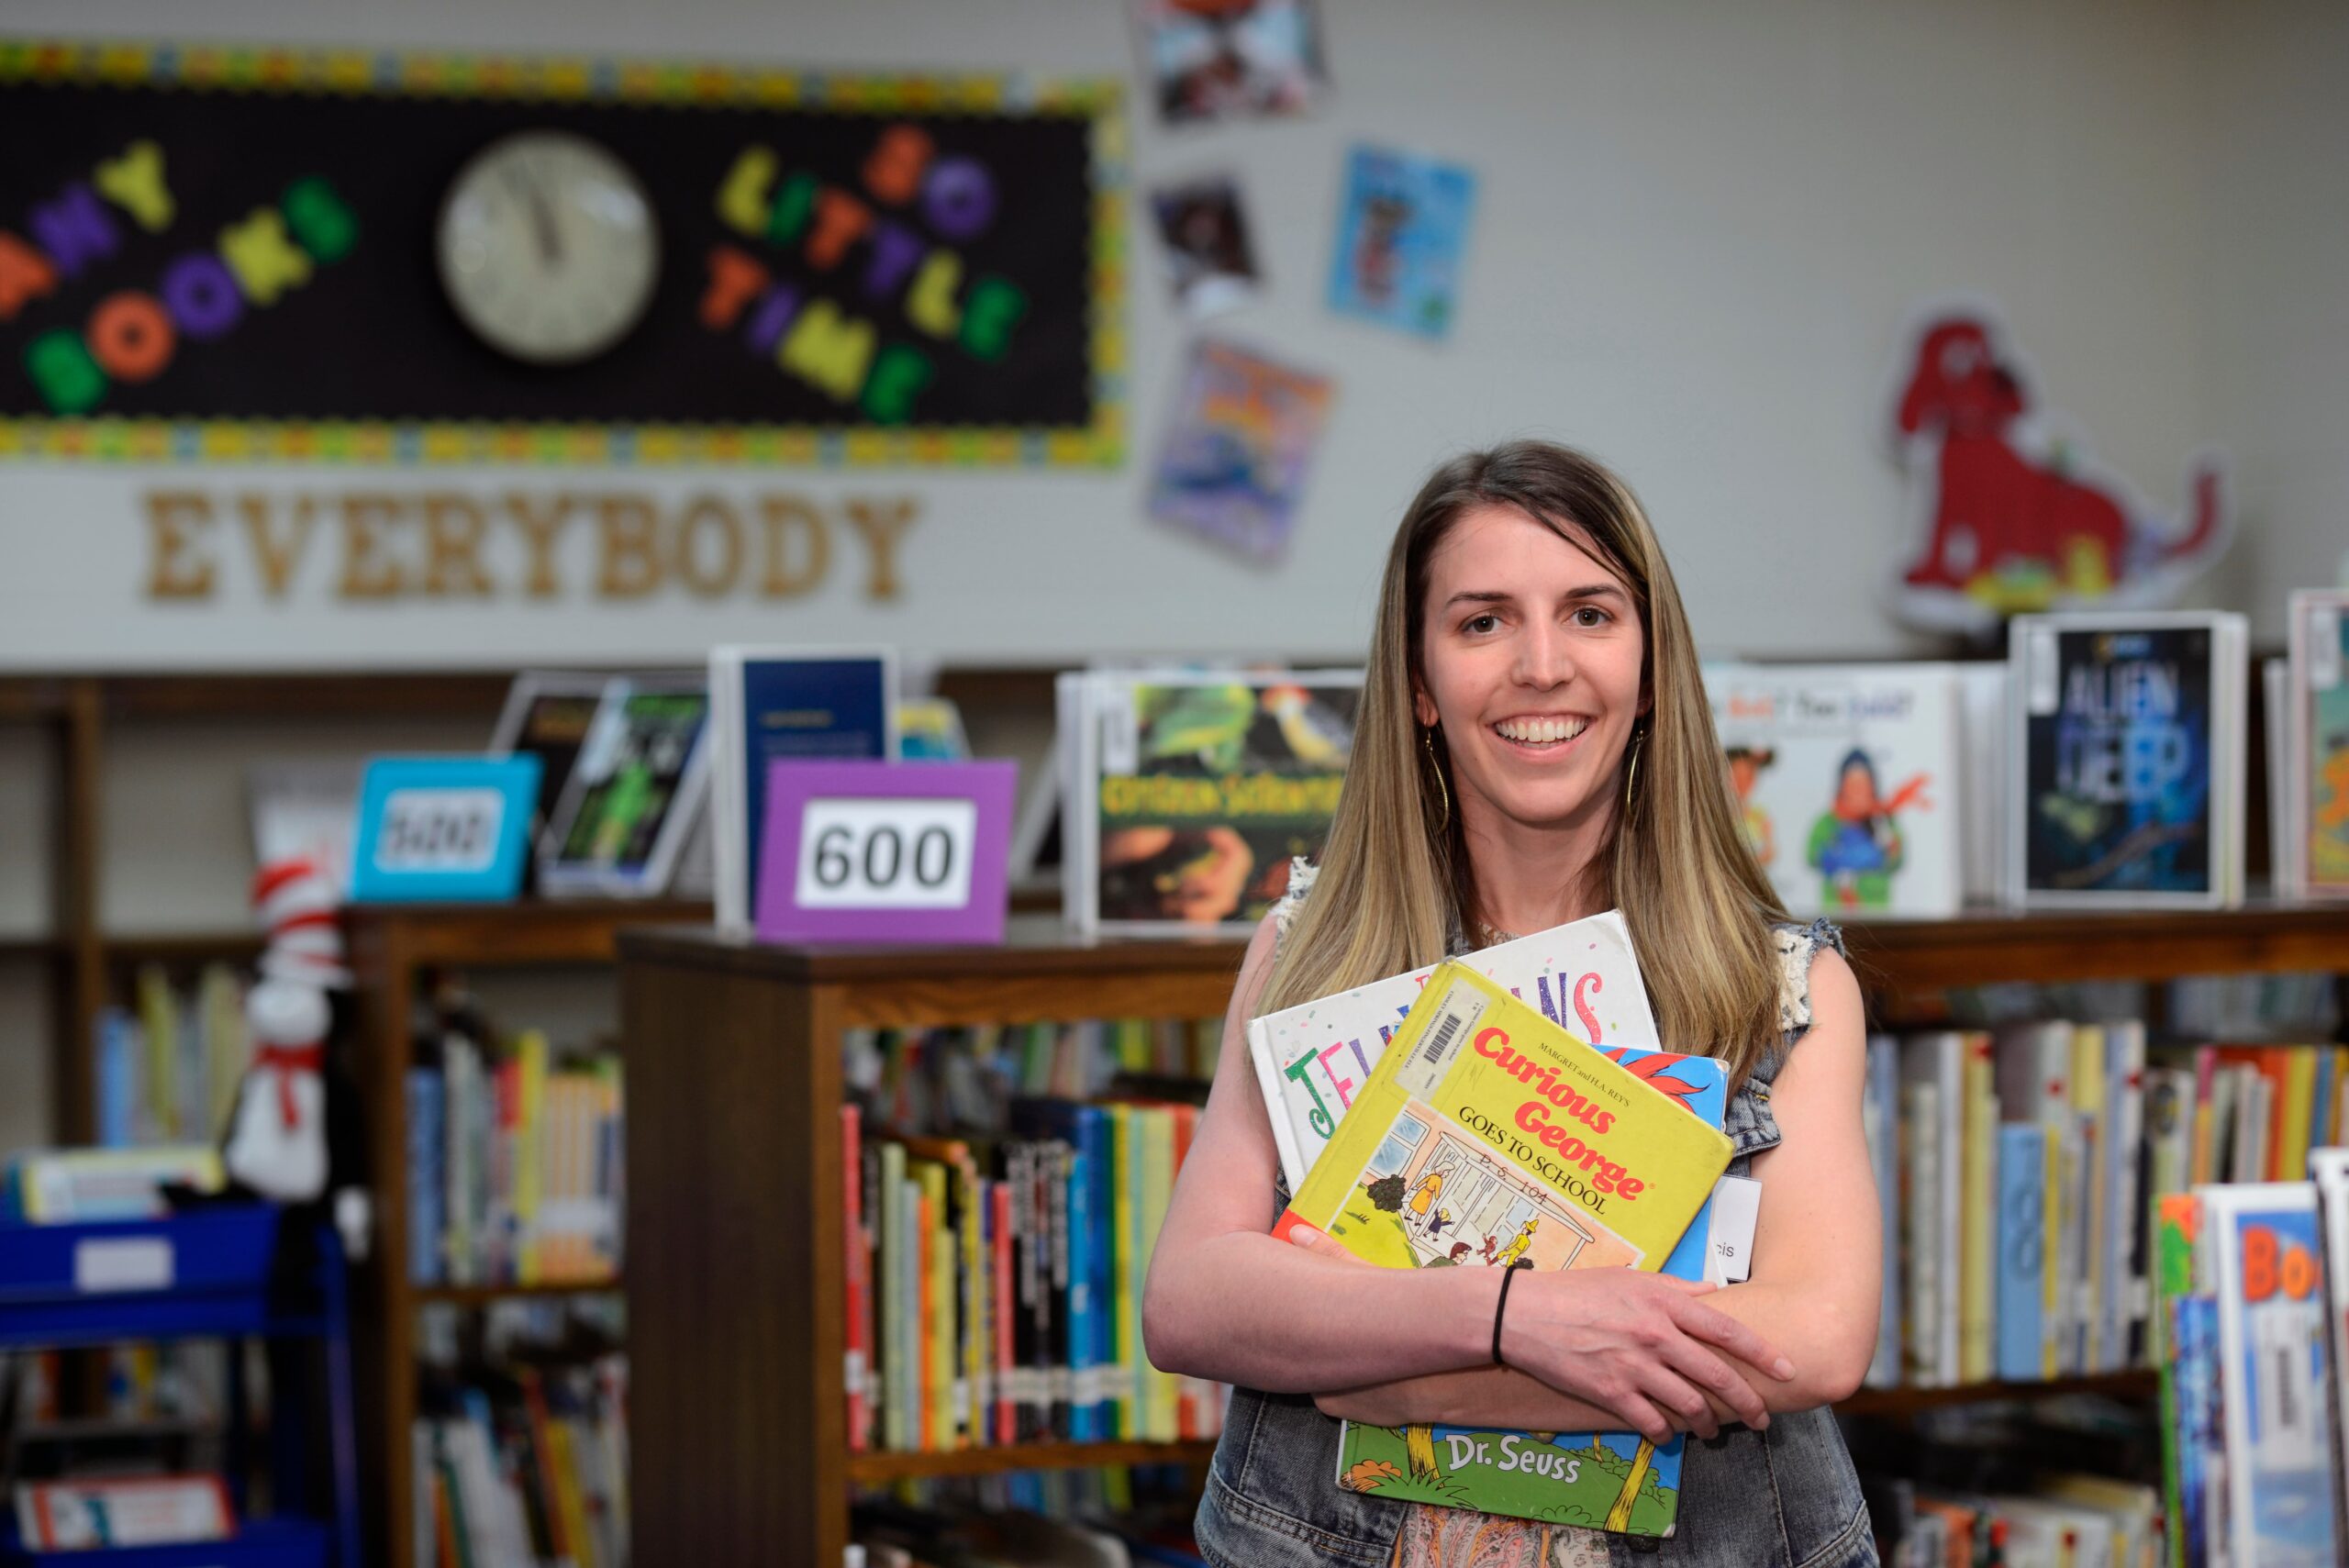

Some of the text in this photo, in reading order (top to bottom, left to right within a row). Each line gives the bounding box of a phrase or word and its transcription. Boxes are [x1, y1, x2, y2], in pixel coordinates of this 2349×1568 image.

[24, 176, 360, 418] BOOKS
[718, 145, 1028, 363] LITTLE
[701, 246, 932, 426] TIME
[143, 490, 919, 604] EVERYBODY
[2066, 661, 2178, 716] ALIEN
[2055, 719, 2191, 802] DEEP
[813, 822, 954, 890] 600
[1474, 1027, 1616, 1134] Curious
[1538, 1042, 1579, 1073] MARGRET
[1576, 1068, 1592, 1082] and
[1459, 1106, 1606, 1215] GOES TO SCHOOL
[1514, 1101, 1645, 1201] George
[1520, 1182, 1548, 1205] 104
[2242, 1221, 2324, 1304] Bo
[1445, 1434, 1582, 1484] Dr. Seuss
